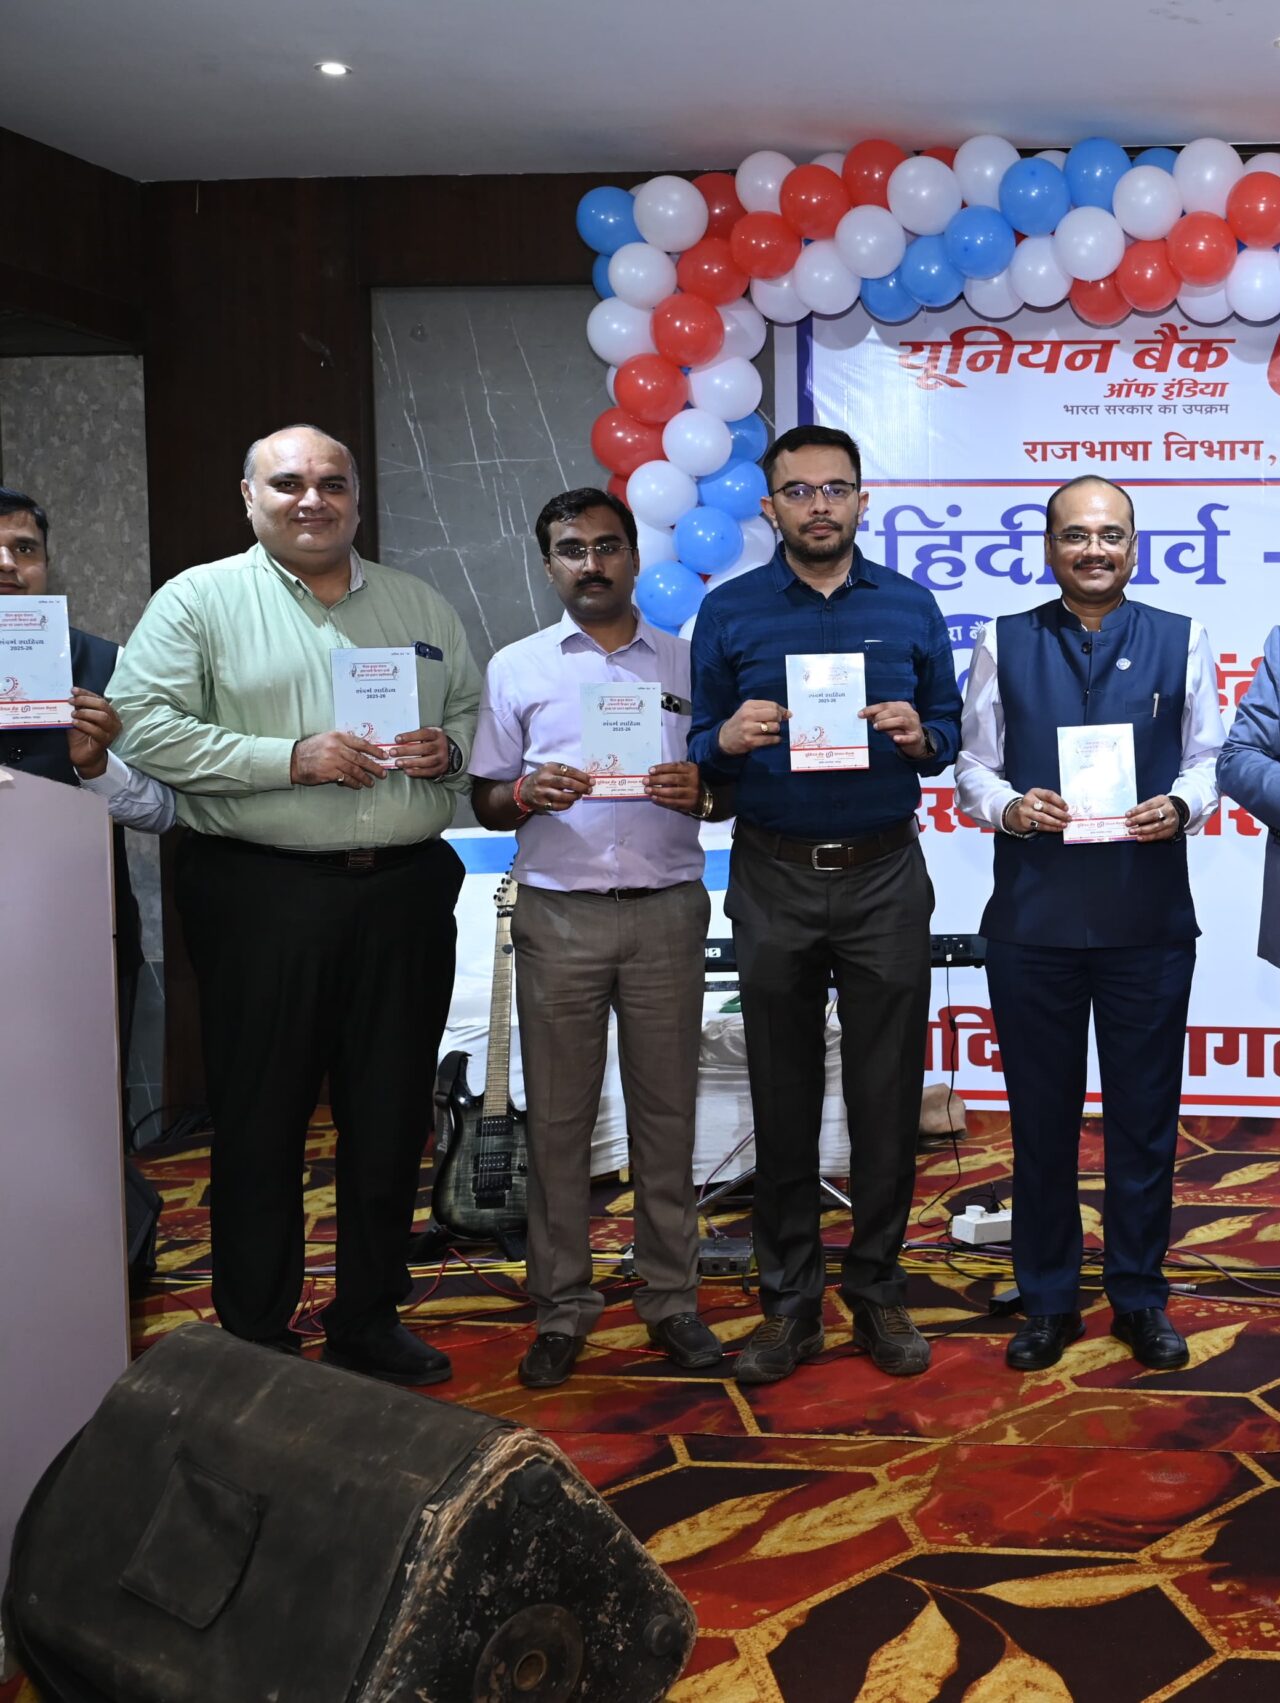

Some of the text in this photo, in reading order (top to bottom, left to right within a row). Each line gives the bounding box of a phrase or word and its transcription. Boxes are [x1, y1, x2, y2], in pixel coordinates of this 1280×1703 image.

[899, 322, 1236, 389] यूनियन बैंक
[1104, 377, 1229, 400] ऑफ इंडिया
[1063, 403, 1229, 416] भारत सरकार का उपक्रम
[1023, 441, 1152, 462] राजभाषा
